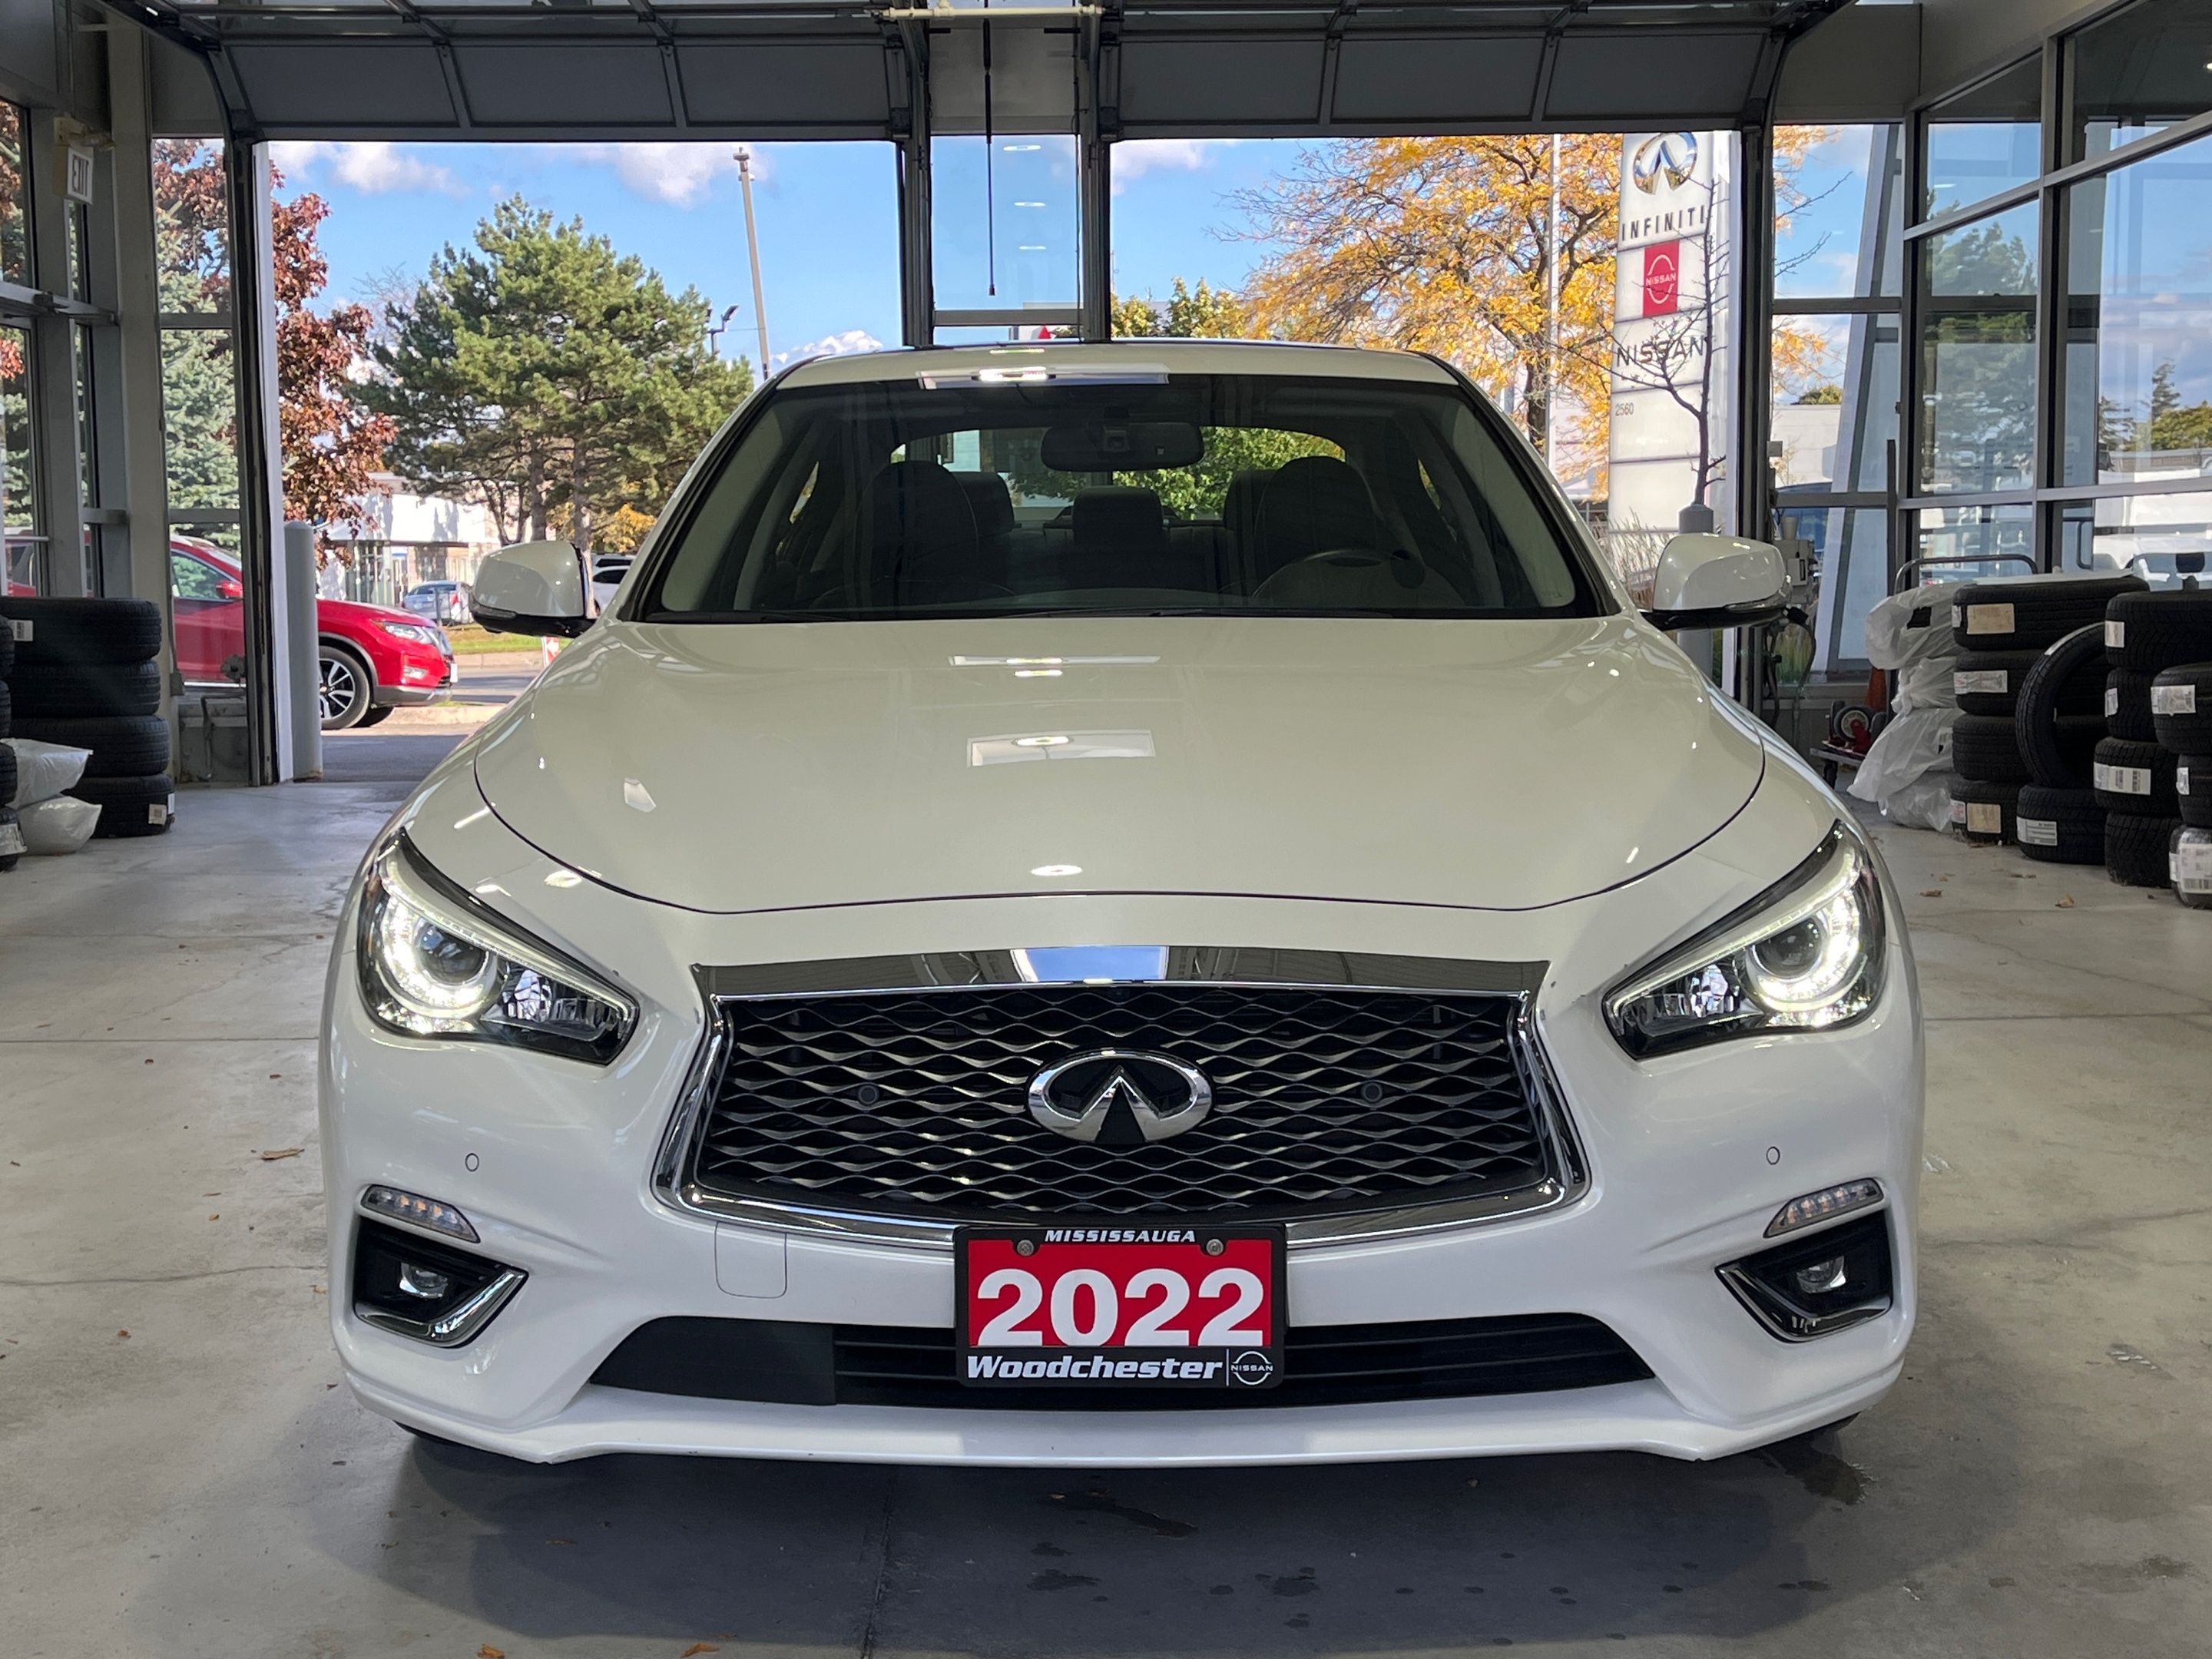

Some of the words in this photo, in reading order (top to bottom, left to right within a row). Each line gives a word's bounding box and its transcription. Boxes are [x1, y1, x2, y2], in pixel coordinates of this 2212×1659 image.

[1621, 205, 1704, 242] INFINITI
[1645, 273, 1677, 286] NISSAN
[1614, 402, 1634, 416] 2560
[1045, 1230, 1196, 1243] MISSISSAUGA
[977, 1267, 1264, 1347] 2022
[967, 1355, 1223, 1379] Woodchester
